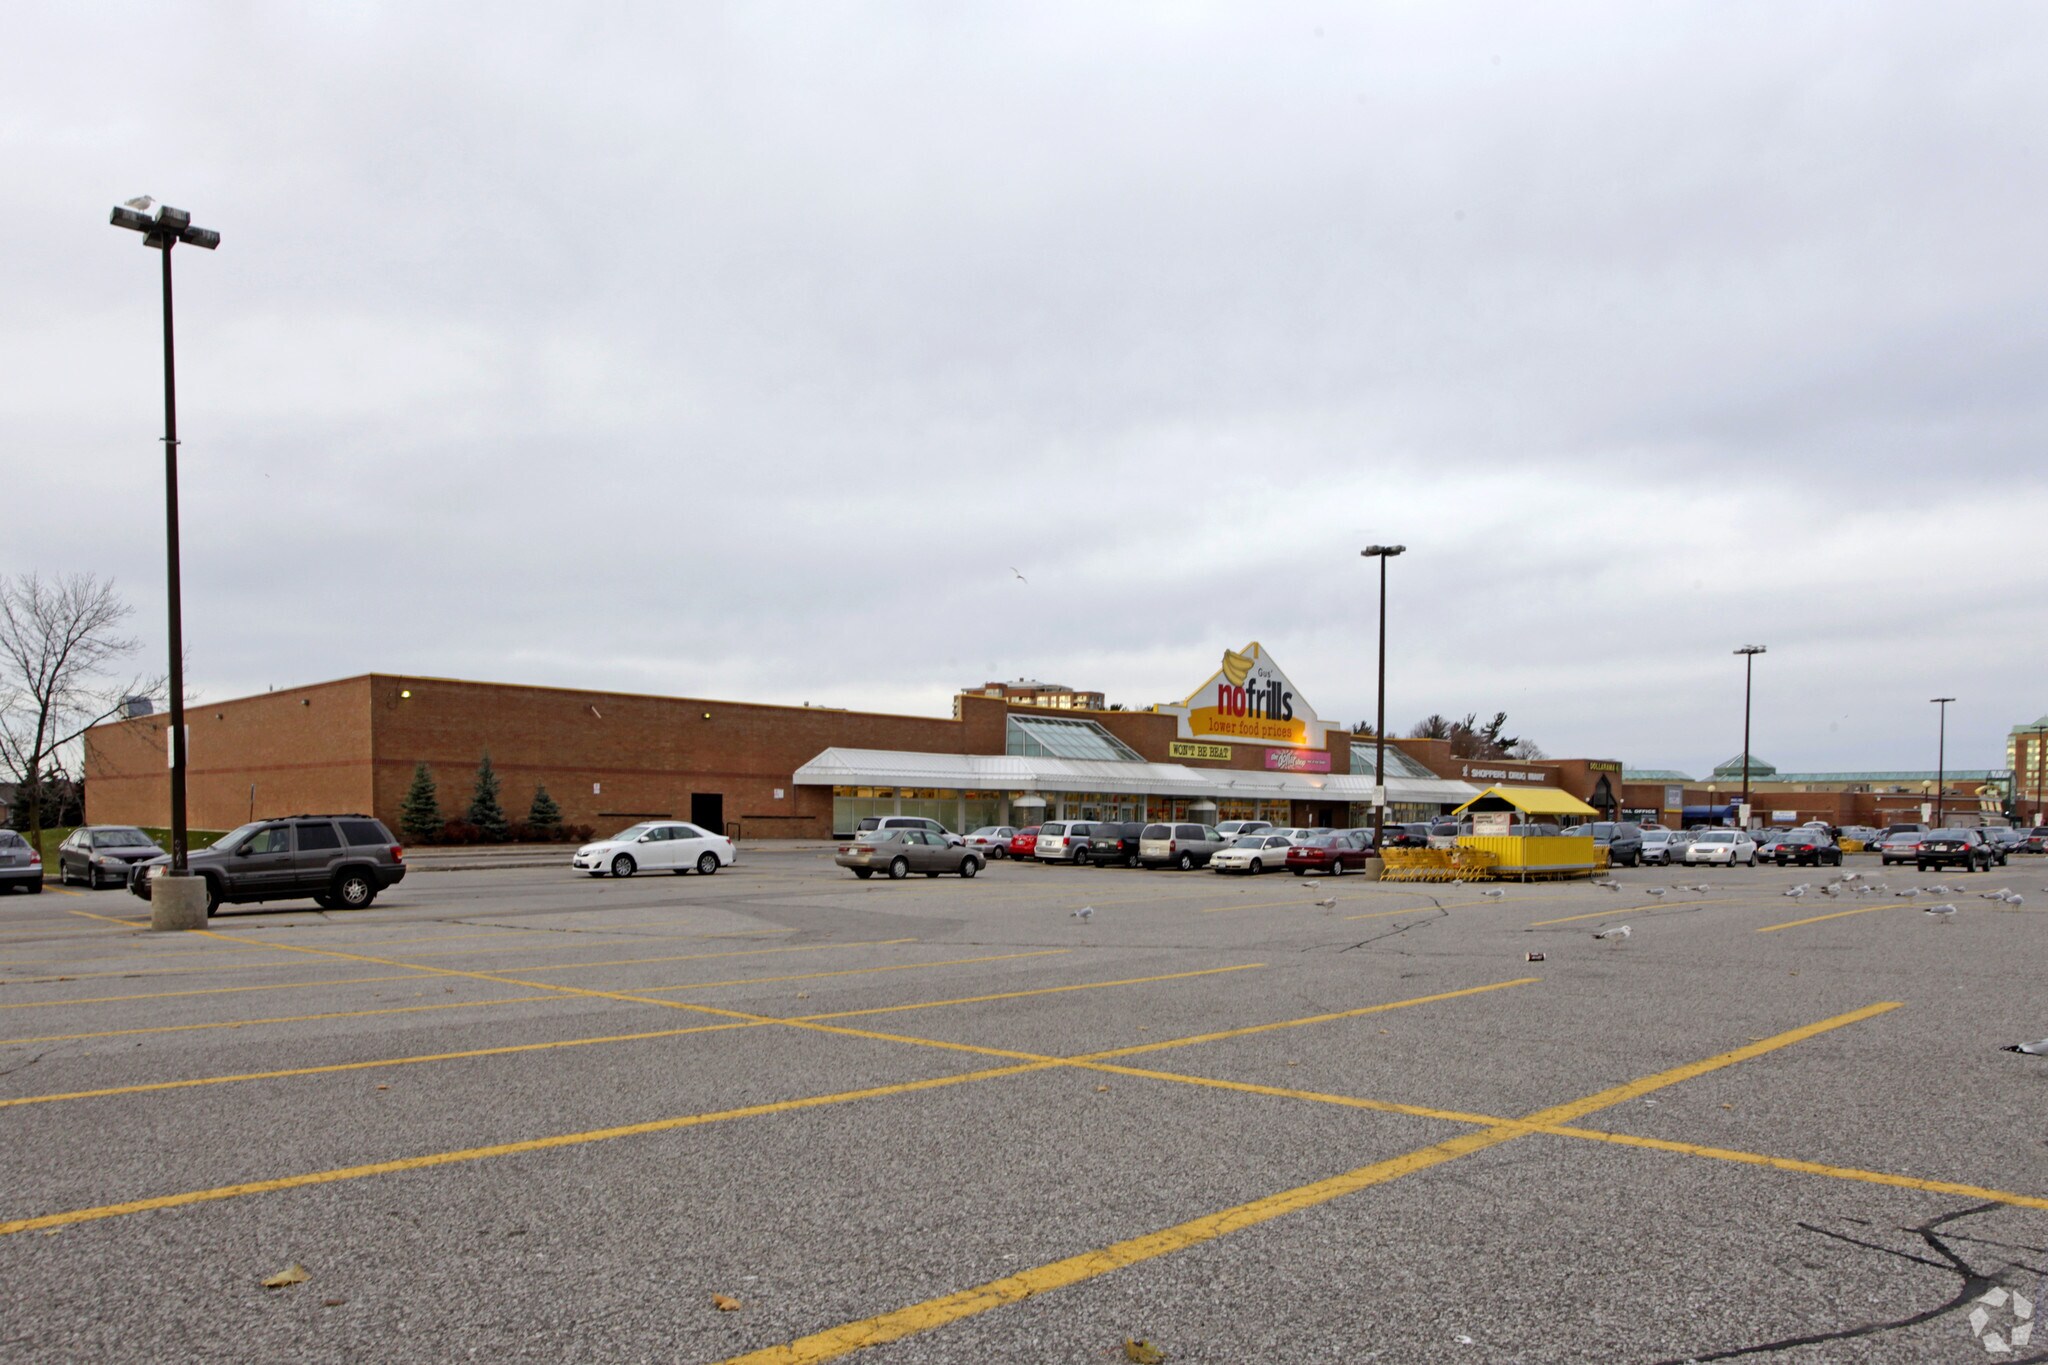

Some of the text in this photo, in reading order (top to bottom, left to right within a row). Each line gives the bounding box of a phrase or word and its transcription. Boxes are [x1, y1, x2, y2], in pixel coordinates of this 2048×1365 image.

[1208, 717, 1292, 739] lower food prices
[1173, 743, 1228, 758] WON'T BE BEAT
[1471, 768, 1545, 781] SHOPPERS DRUG MART
